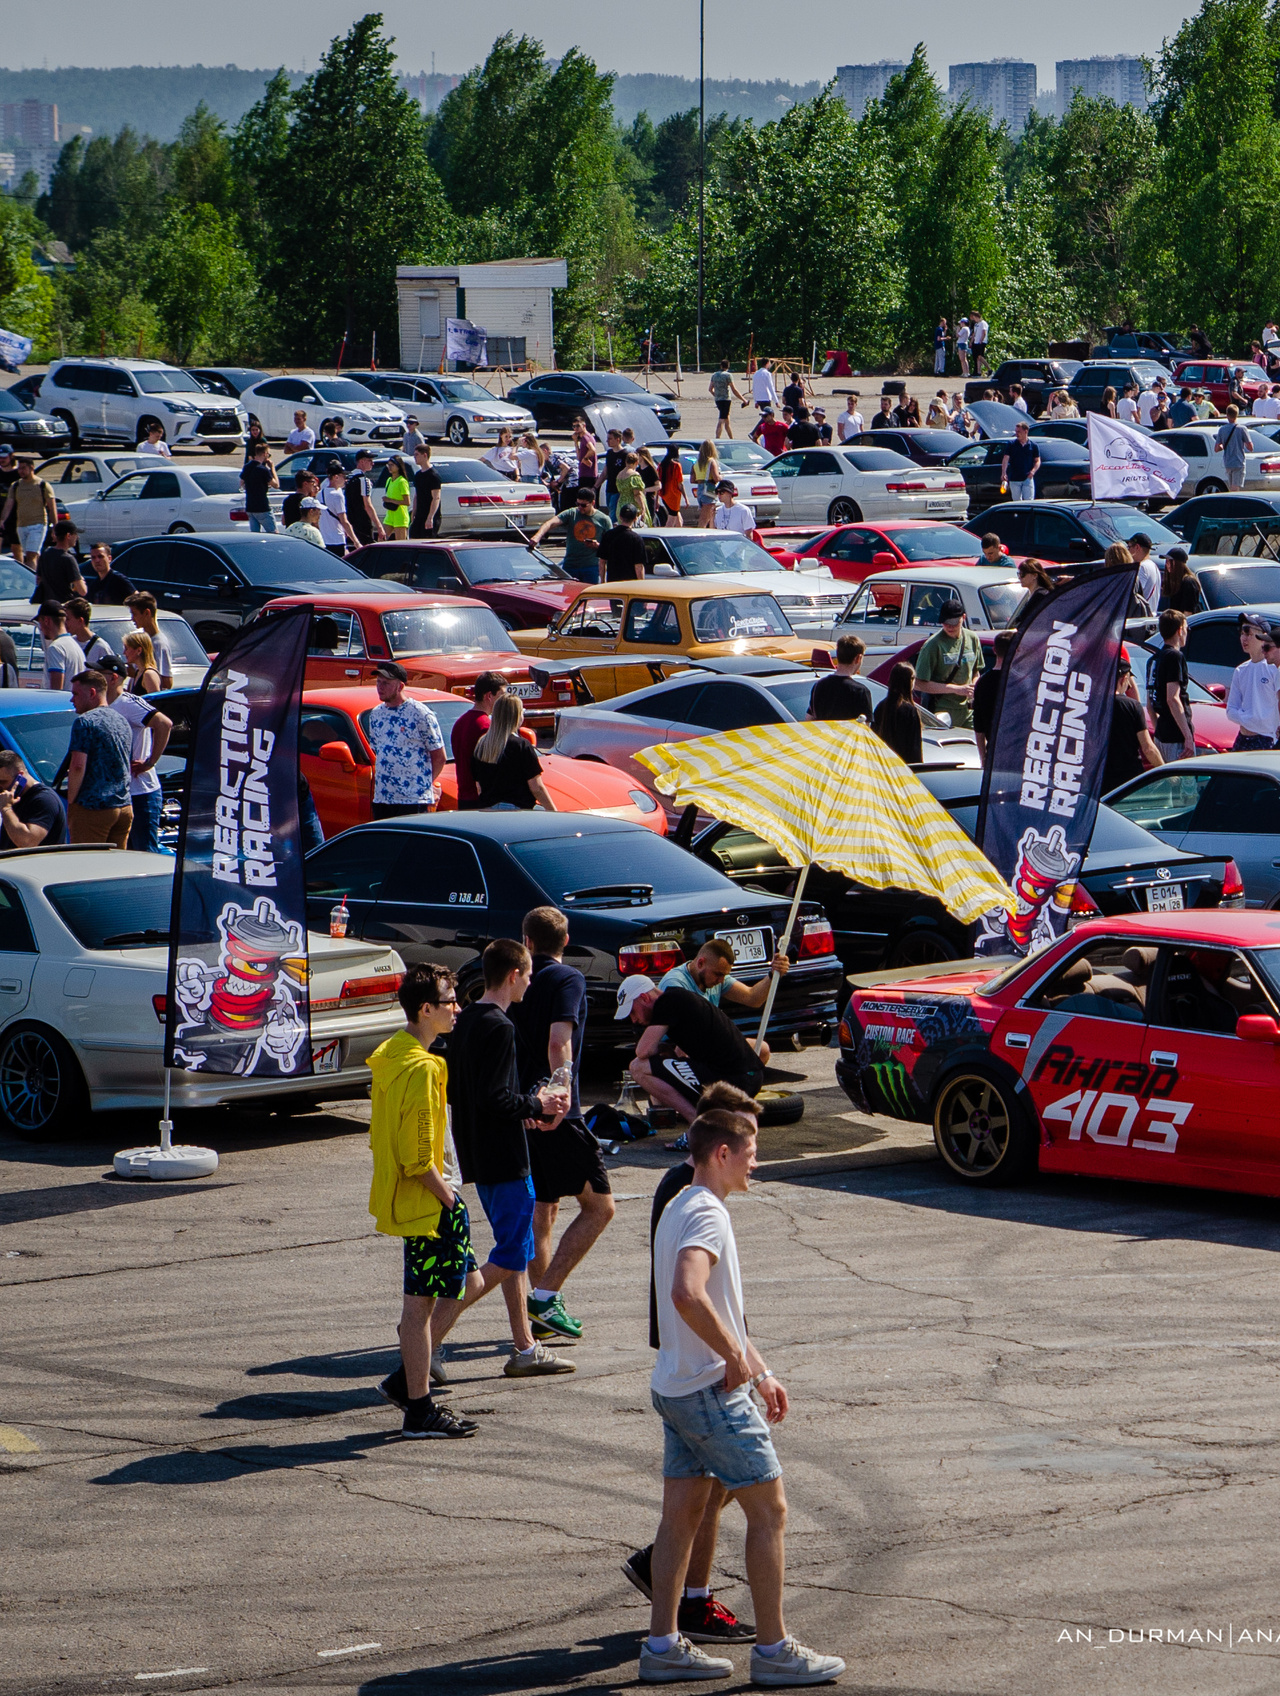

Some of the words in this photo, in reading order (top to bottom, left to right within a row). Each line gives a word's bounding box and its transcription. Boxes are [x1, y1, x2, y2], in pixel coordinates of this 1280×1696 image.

[1019, 620, 1078, 811] REACTION
[1048, 671, 1093, 818] RACING
[212, 669, 250, 884] REACTION
[242, 728, 278, 887] RACING
[673, 1061, 700, 1085] NIKE
[864, 1024, 895, 1043] CUSTOM
[895, 1026, 917, 1044] RACE
[416, 1108, 434, 1162] CALVIN
[1042, 1089, 1194, 1154] 403
